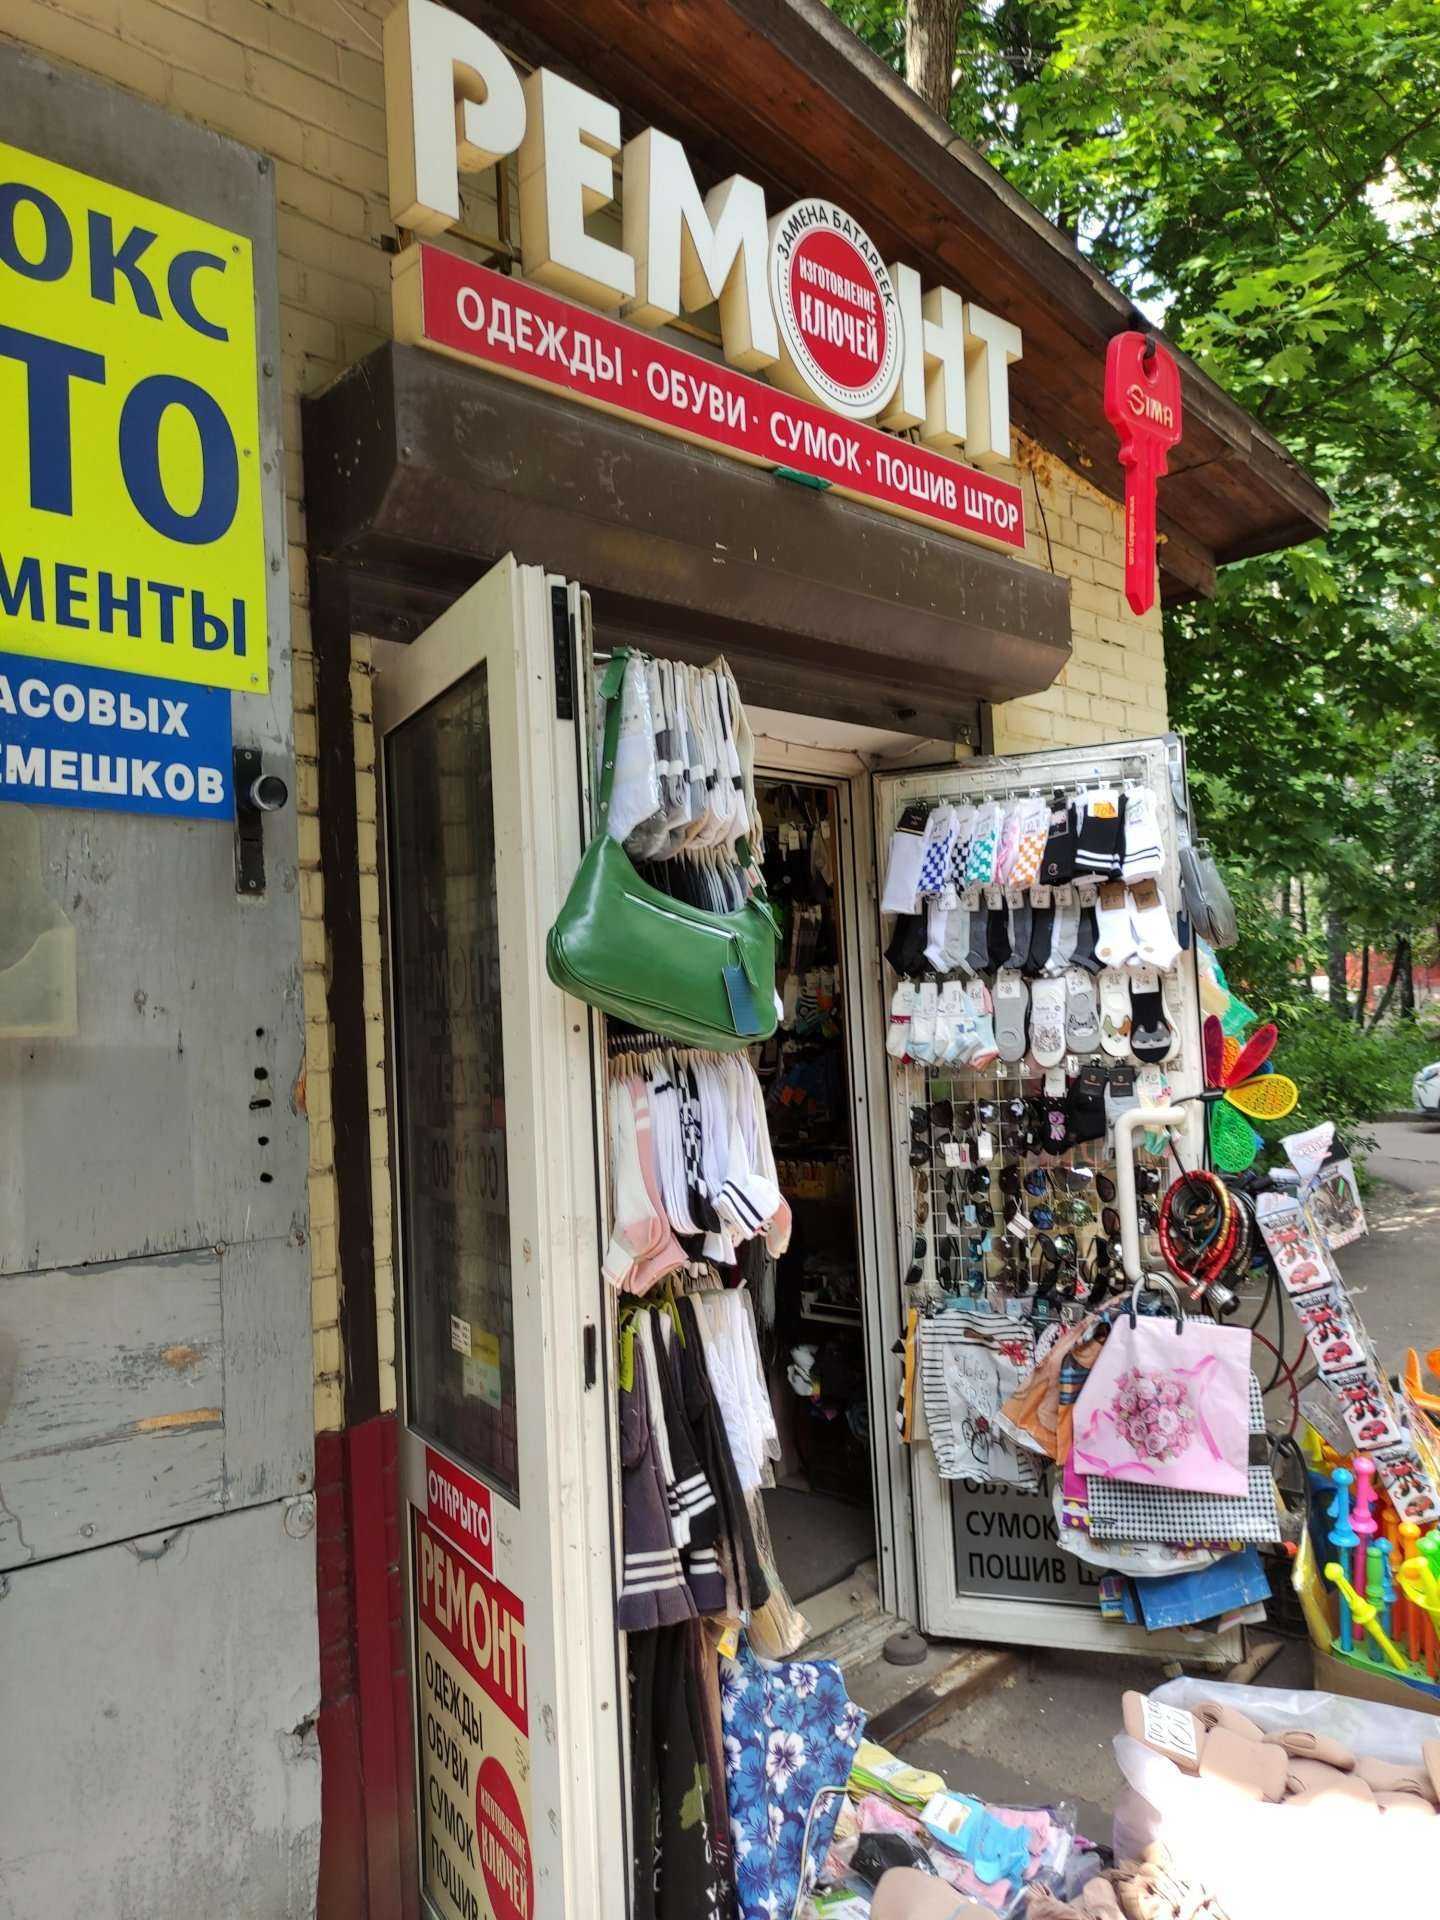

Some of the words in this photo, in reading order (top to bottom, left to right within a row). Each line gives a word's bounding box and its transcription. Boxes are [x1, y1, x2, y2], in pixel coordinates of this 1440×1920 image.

[386, 0, 1023, 464] РЕМОНТ
[777, 204, 829, 260] ЗАМЕНА
[832, 211, 895, 306] БАТАРЕЕК
[799, 255, 877, 314] ИЗГОТОВЛЕНИЕ
[799, 290, 878, 364] КЛЮЧЕЙ
[456, 287, 623, 386] ОДЕЖДЫ
[646, 361, 747, 432] ОБУВИ
[770, 412, 862, 475] СУМОК
[876, 451, 957, 510] ПОШИВ
[964, 485, 1019, 532] ШТОР
[0, 744, 224, 804] МЕШКОВ
[428, 1468, 491, 1546] ОТКРЫТО
[966, 1511, 1058, 1541] СУМОК
[969, 1552, 1066, 1584] ПОШИВ
[420, 1531, 525, 1713] РЕМОНТ
[426, 1650, 484, 1751] ОДЕЖДЫ
[427, 1713, 469, 1797] ОБУВИ
[429, 1774, 475, 1869] СУМОК
[480, 1785, 527, 1865] ИЗГОТОВЛЕНИЕ
[481, 1822, 528, 1920] КЛЮЧЕЙ
